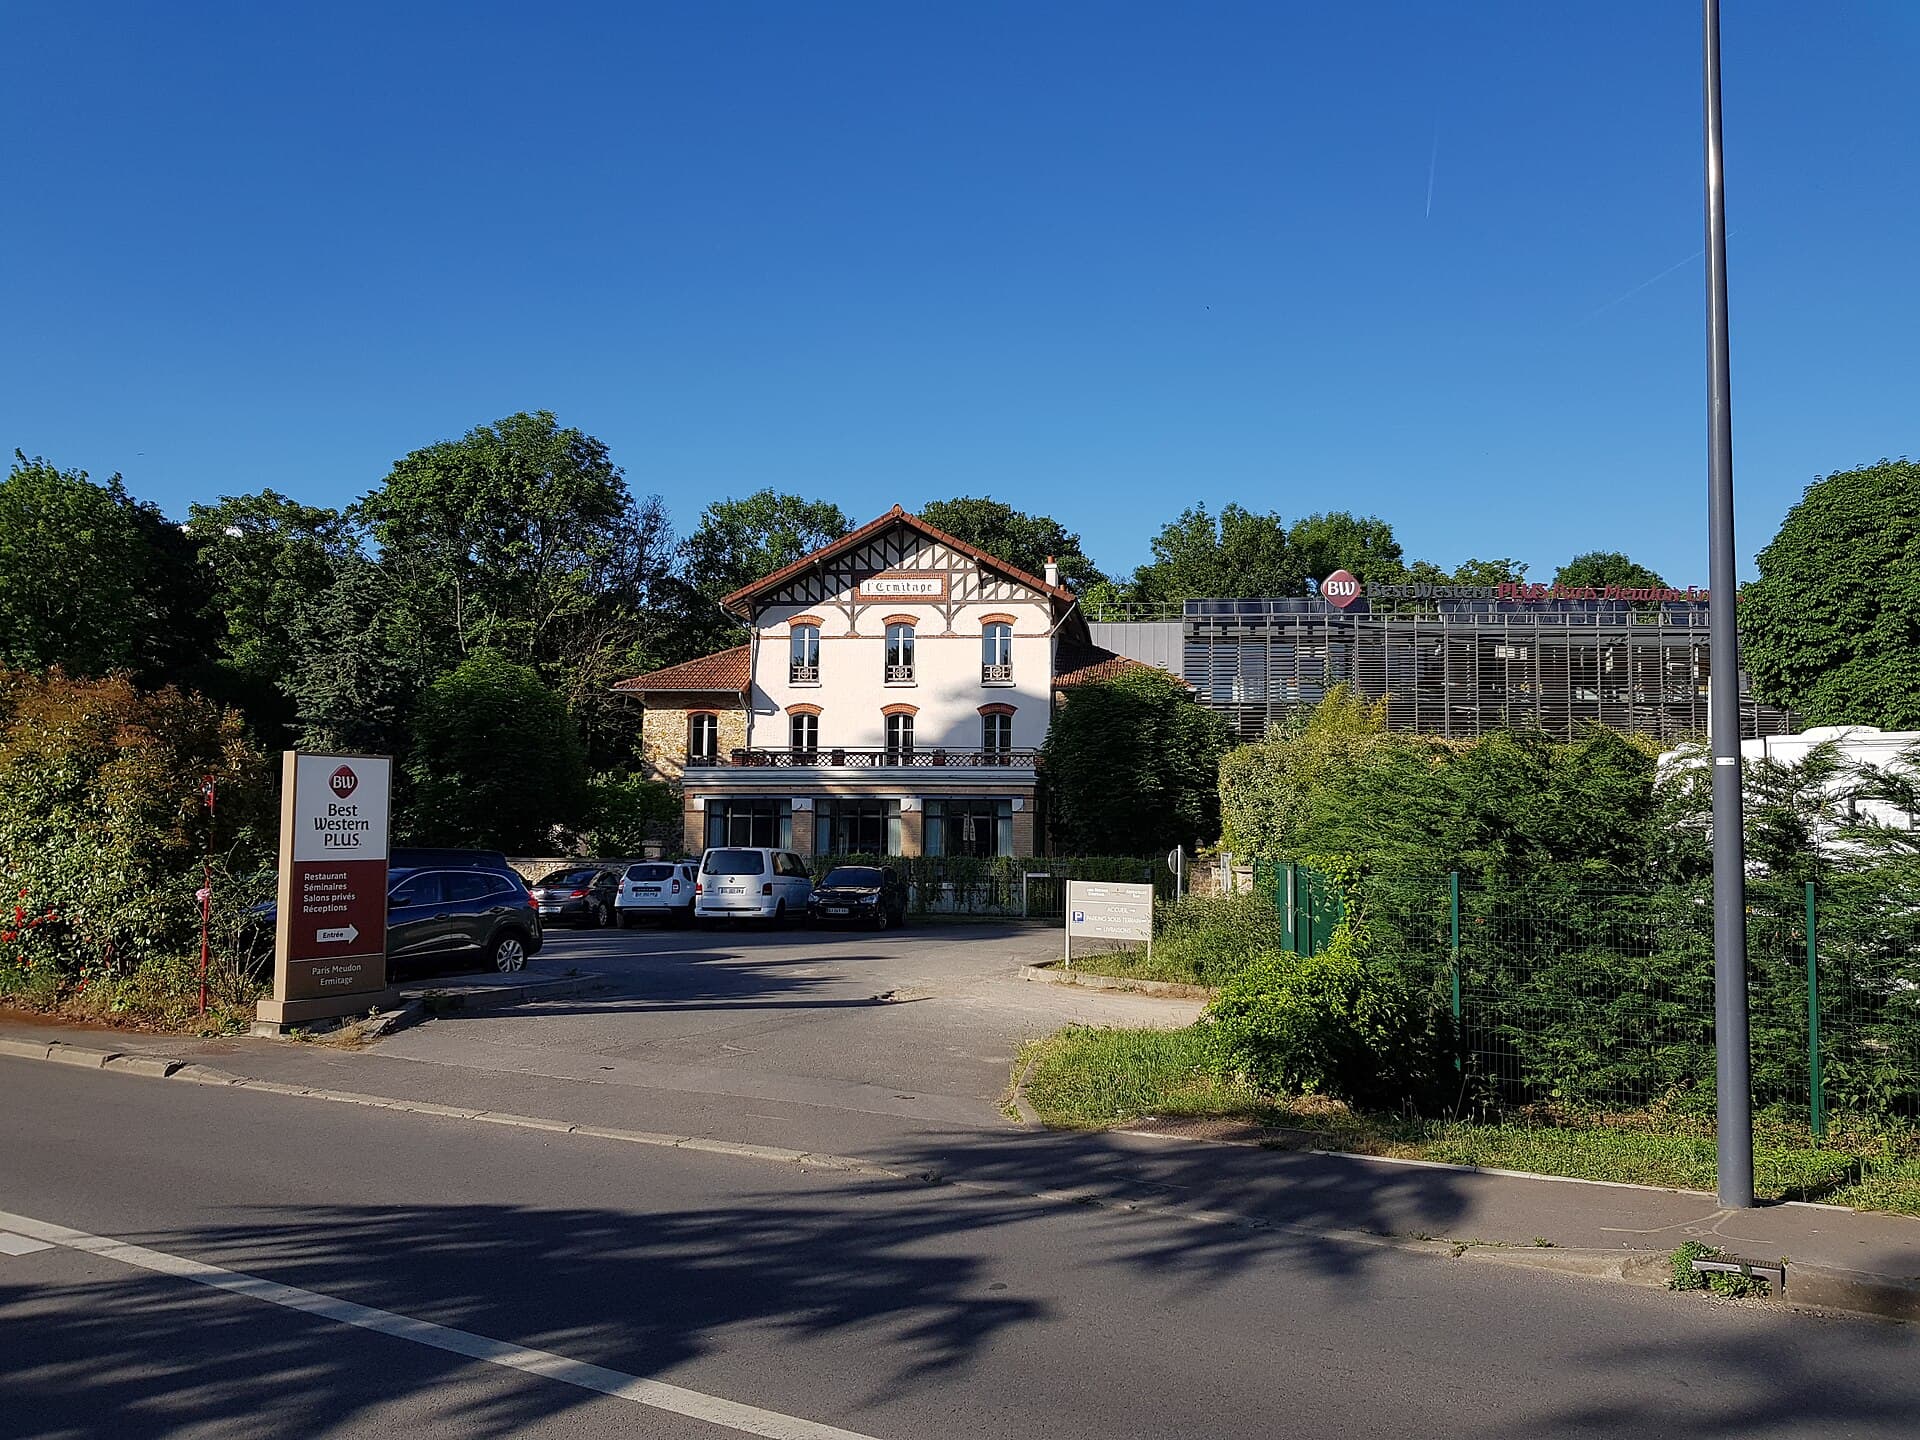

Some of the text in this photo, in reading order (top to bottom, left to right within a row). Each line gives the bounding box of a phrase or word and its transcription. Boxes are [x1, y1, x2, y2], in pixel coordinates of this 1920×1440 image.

[1327, 581, 1355, 596] BW
[1367, 582, 1410, 598] Best
[1412, 582, 1496, 598] Western
[1497, 582, 1548, 599] PLUS
[333, 775, 355, 789] BW
[328, 803, 358, 816] Best
[314, 817, 369, 831] Western
[304, 872, 347, 881] Restaurant
[303, 882, 347, 891] Séminaires
[303, 892, 356, 902] Salons privés
[303, 904, 348, 913] Réceptions
[311, 964, 361, 975] Paris Meudon
[320, 976, 353, 986] Ermitage
